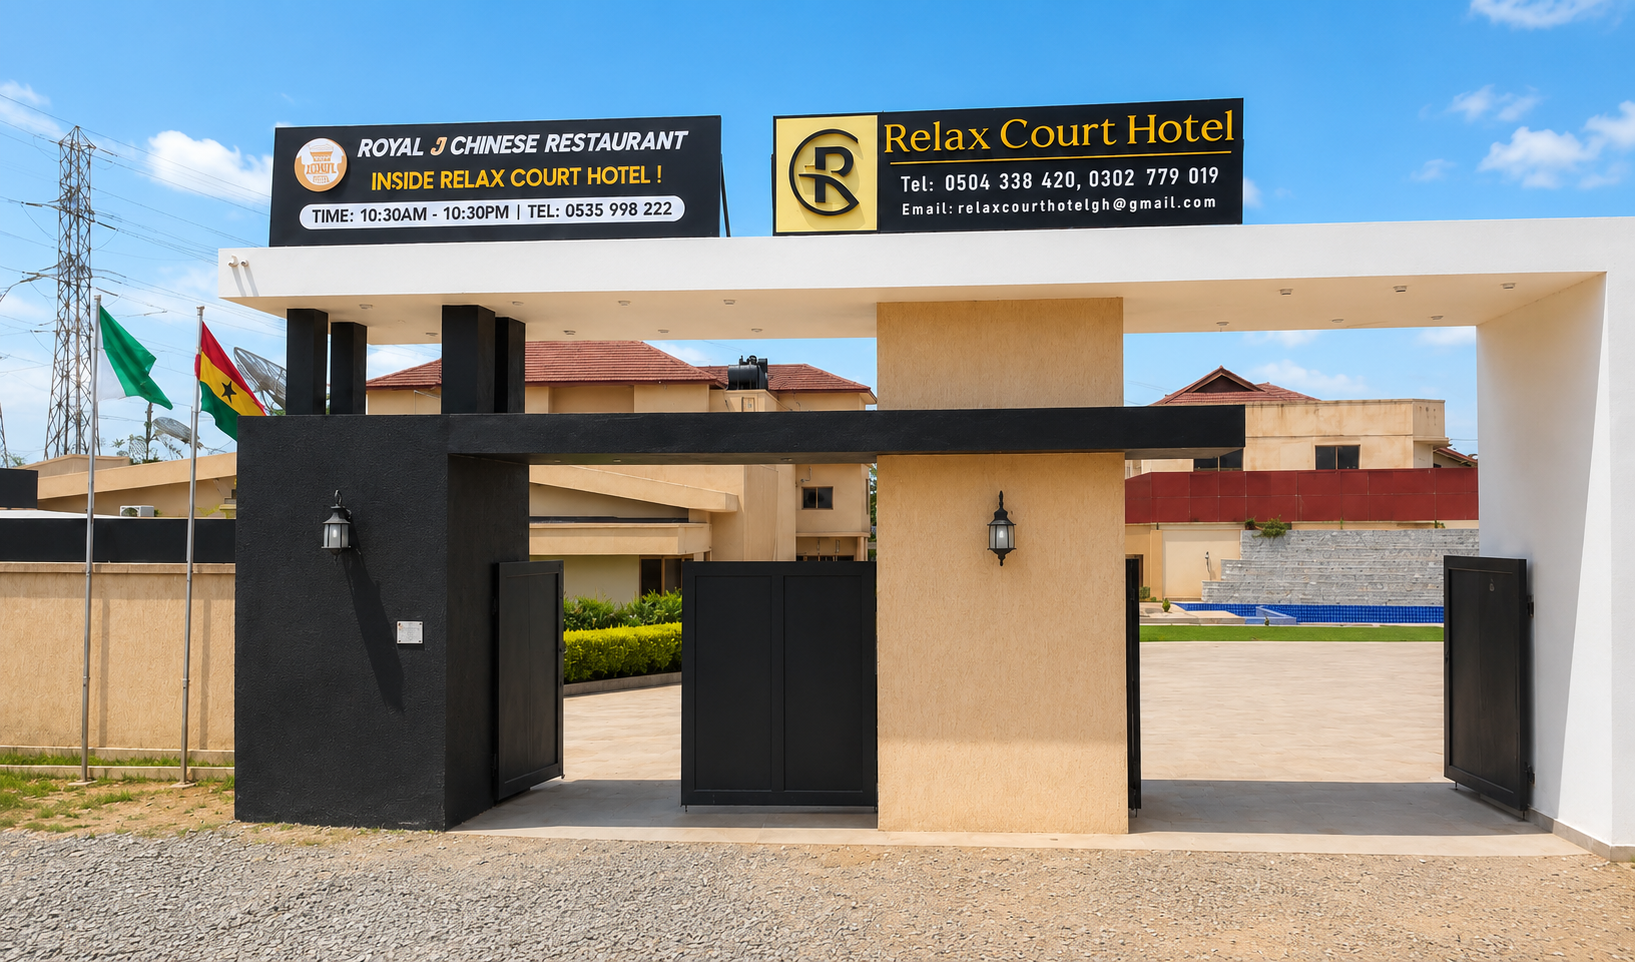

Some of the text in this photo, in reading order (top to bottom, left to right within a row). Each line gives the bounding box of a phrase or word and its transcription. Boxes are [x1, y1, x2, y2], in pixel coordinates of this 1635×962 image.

[885, 110, 1233, 152] Relax Court Hotel
[357, 138, 423, 157] ROYAL
[451, 135, 538, 155] CHINESE
[545, 131, 689, 152] RESTAURANT
[372, 164, 662, 190] INSIDE RELAX COURT HOTEL !
[901, 167, 1218, 192] Tel: 0504 338 420, 0302 779 019
[312, 209, 353, 223] TIME:
[361, 207, 427, 222] 10:30AM
[444, 205, 508, 220] 10:30PM
[528, 204, 559, 218] TEL:
[566, 203, 603, 217] 0535
[610, 203, 637, 216] 998
[644, 202, 672, 215] 222
[903, 196, 1215, 215] Email: relaxcourthotelgh@gmail.com
